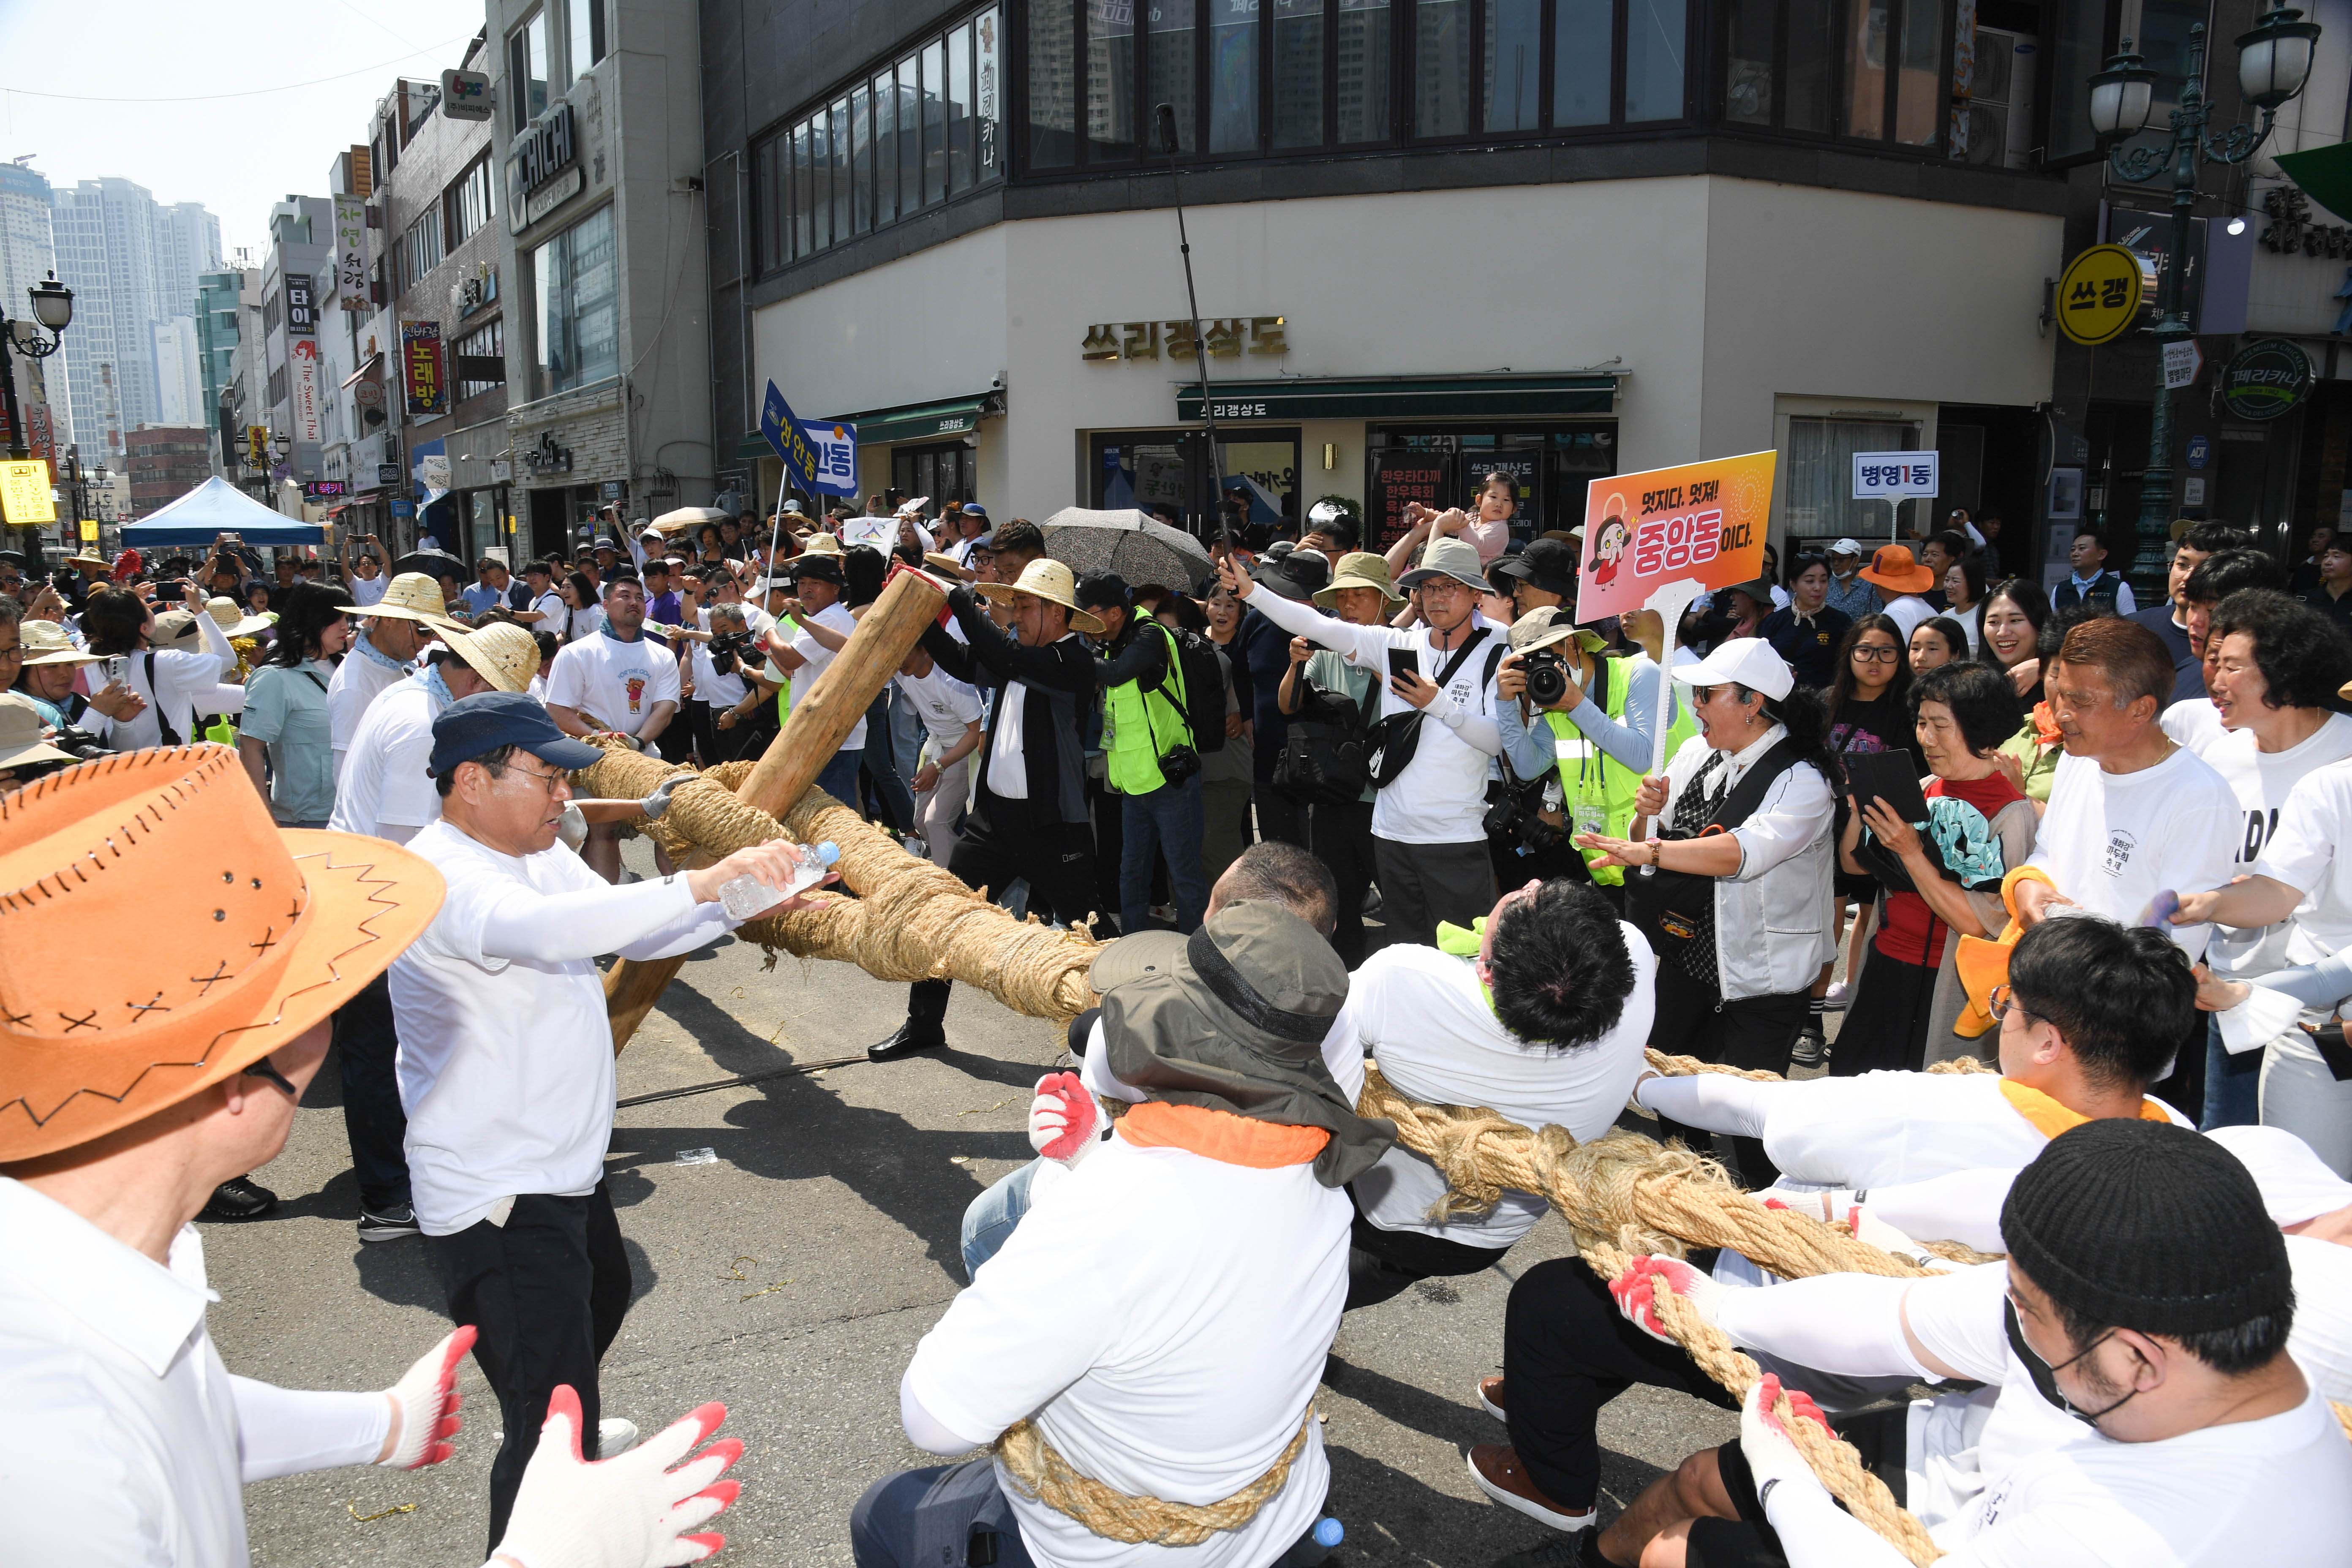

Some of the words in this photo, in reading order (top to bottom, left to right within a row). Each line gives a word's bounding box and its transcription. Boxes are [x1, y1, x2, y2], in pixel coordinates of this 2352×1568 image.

[452, 75, 483, 100] bps
[447, 103, 490, 114] (주)비피에스
[981, 68, 994, 167] 페리카나
[518, 106, 572, 194] CHICHI
[2117, 226, 2141, 245] elicana
[338, 207, 364, 290] 자연처럼
[2069, 277, 2128, 310] 쓰갱
[290, 289, 310, 323] 타이
[403, 325, 439, 338] 신바람
[1081, 317, 1287, 360] 쓰리갱상도
[2238, 343, 2277, 363] PREMIUM
[2278, 344, 2305, 370] CHICKEN
[302, 364, 313, 382] The
[412, 340, 436, 407] 노래방
[2232, 369, 2303, 387] 페리카나
[304, 381, 314, 416] Sweet
[360, 390, 377, 399] 코빈
[307, 418, 317, 440] Thai
[939, 418, 964, 430] 쓰리갱상도
[2190, 446, 2206, 458] ADT
[1381, 470, 1441, 483] 한우타다끼
[1862, 465, 1932, 487] 병영1동
[1386, 485, 1435, 498] 한우육회
[1642, 487, 1685, 515] 멋지다.
[1386, 500, 1435, 513] 육사미
[1451, 689, 1470, 698] 마두희
[1369, 747, 1383, 771] NIKE
[2106, 845, 2129, 863] 마두희
[2112, 837, 2130, 851] 태화강
